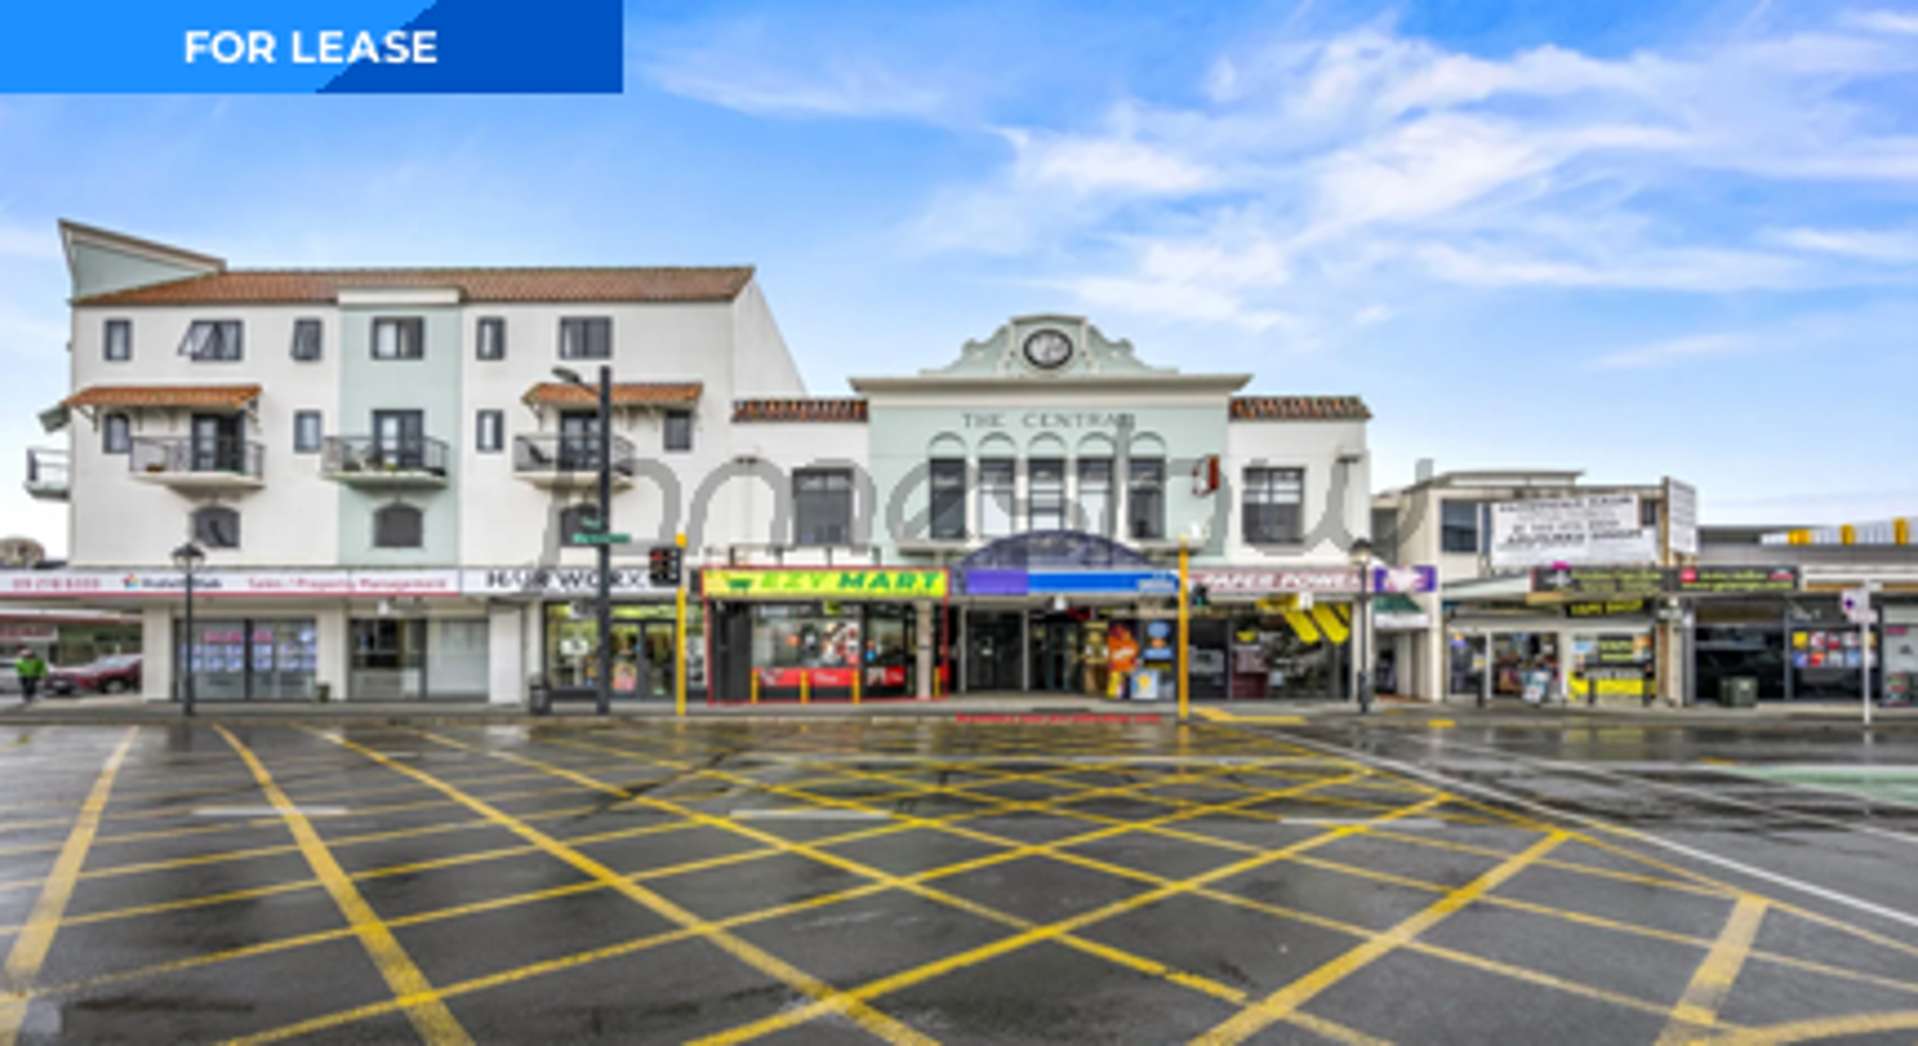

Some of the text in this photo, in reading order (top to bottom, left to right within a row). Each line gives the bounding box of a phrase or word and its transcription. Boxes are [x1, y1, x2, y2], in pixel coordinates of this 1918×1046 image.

[963, 413, 1007, 428] THE
[761, 571, 941, 589] EZY MART
